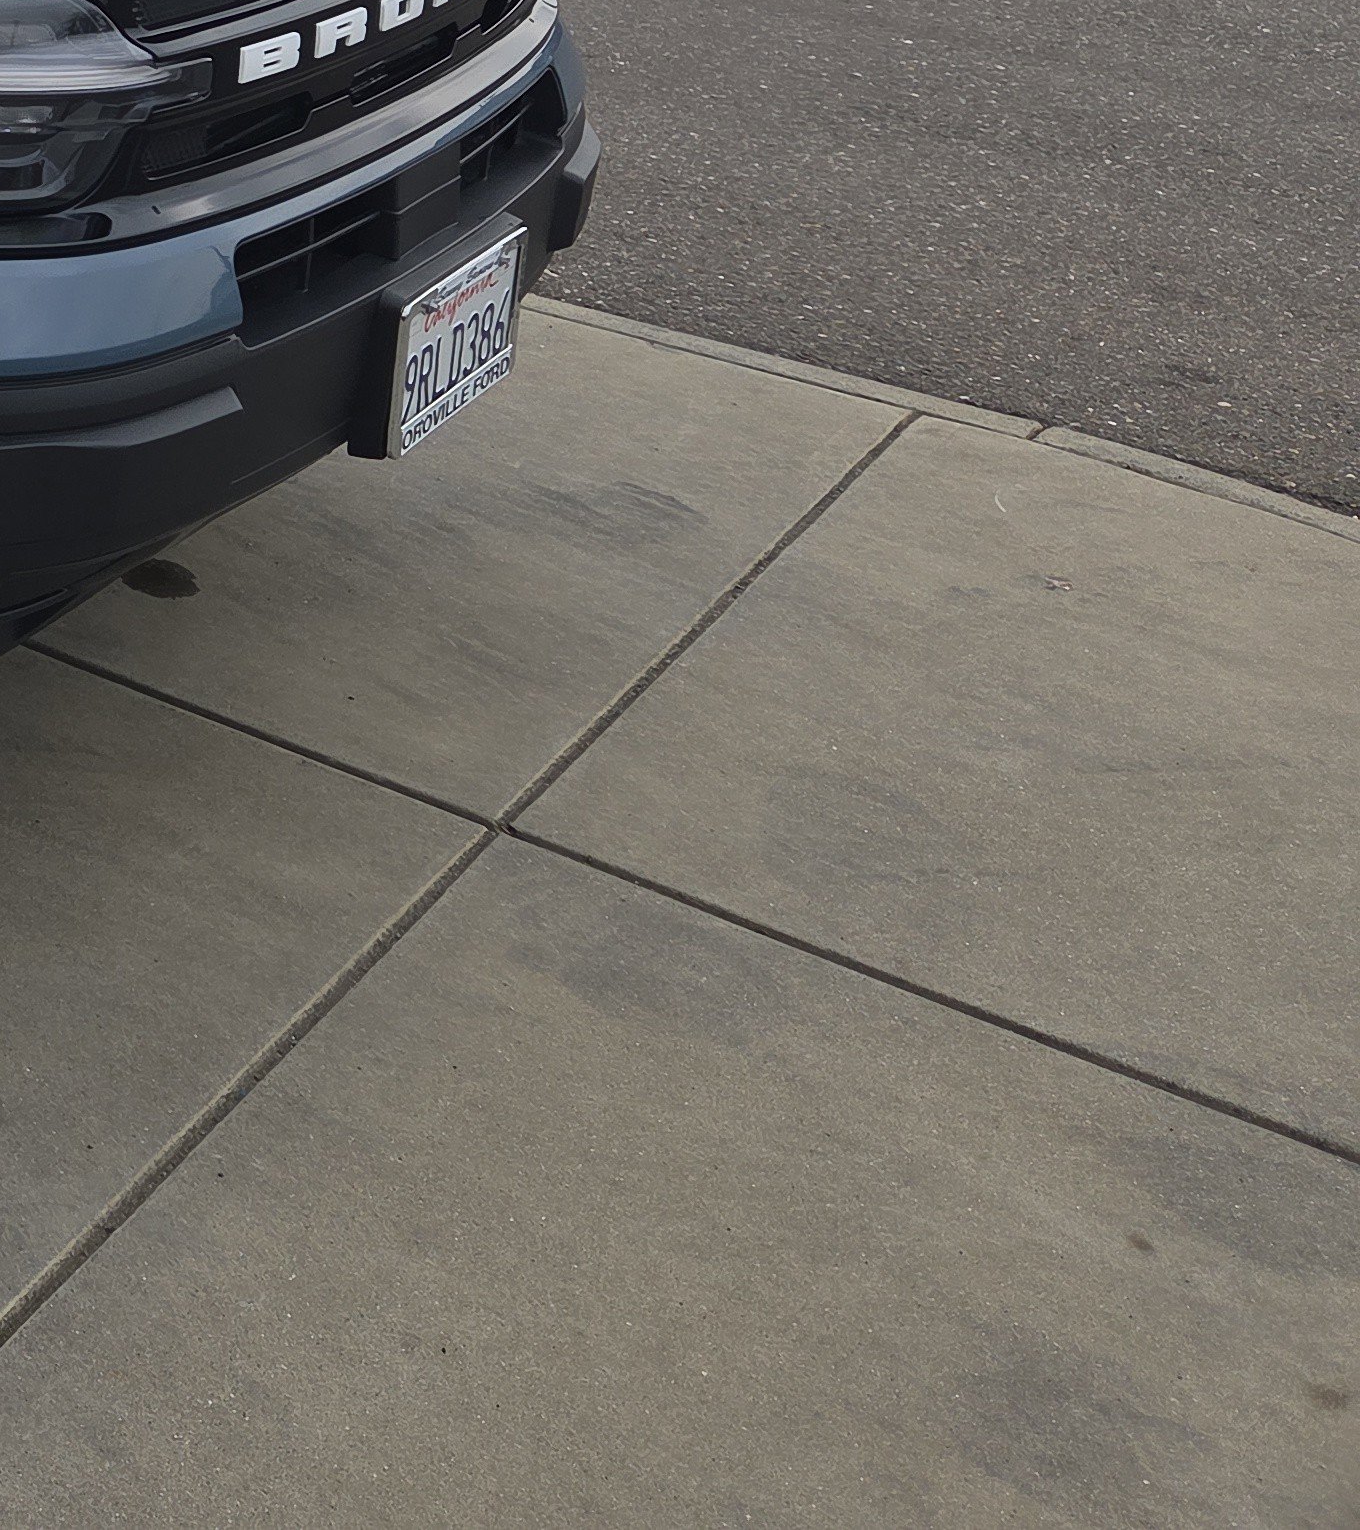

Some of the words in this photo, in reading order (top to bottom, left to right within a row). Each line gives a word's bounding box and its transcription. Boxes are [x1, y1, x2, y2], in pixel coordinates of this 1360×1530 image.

[402, 288, 511, 426] 9RLD386
[402, 385, 471, 451] OROVILLE
[472, 355, 511, 398] FORD
